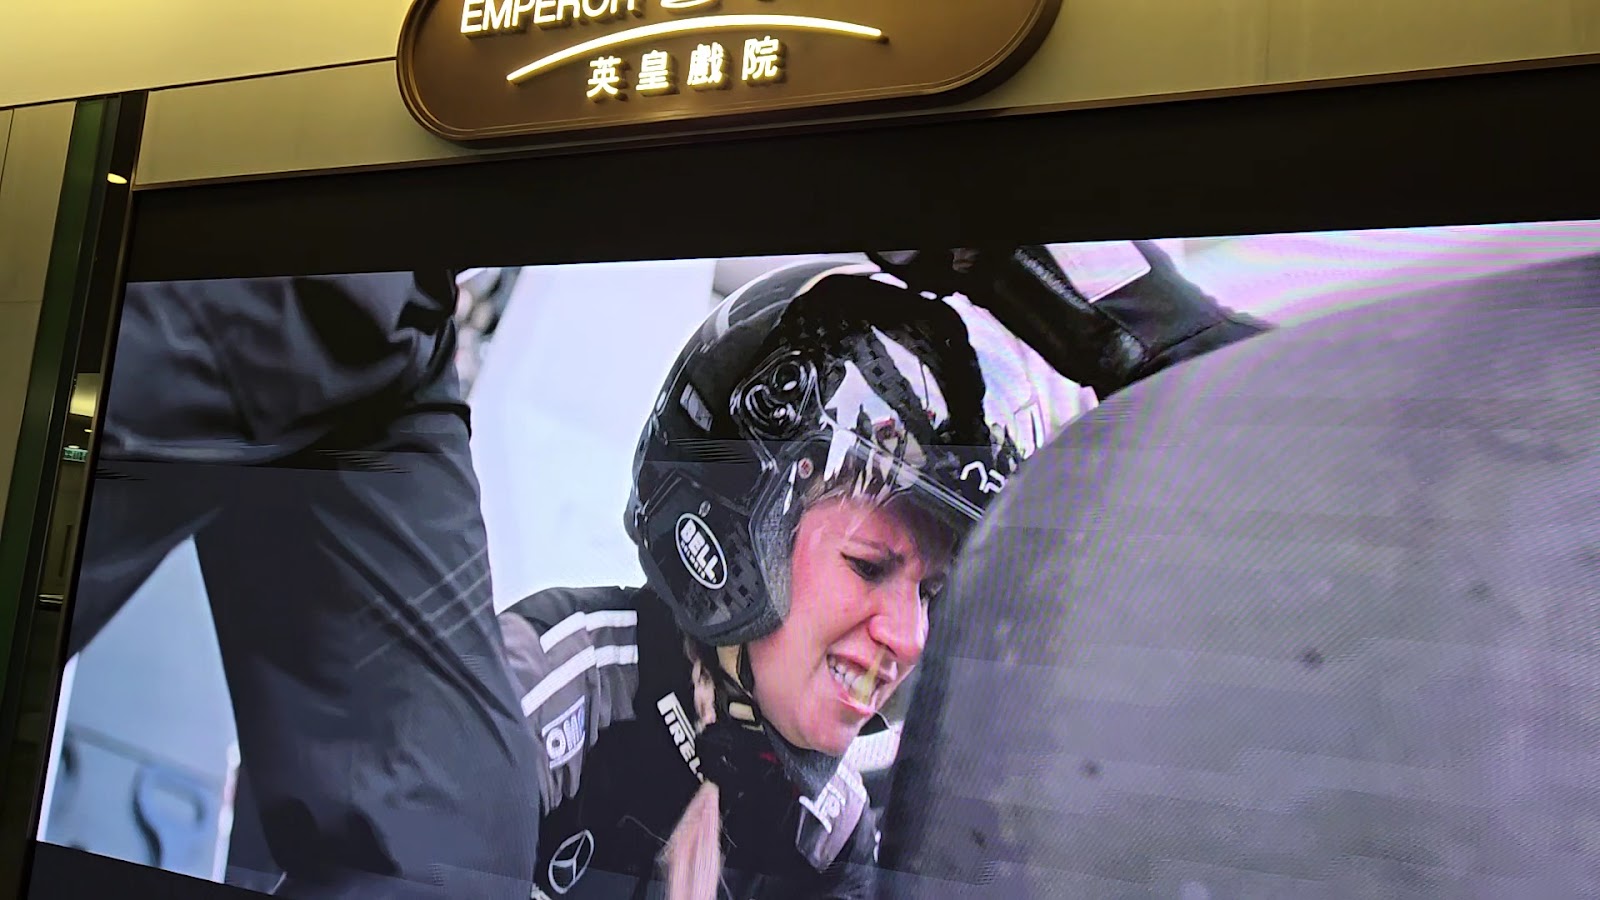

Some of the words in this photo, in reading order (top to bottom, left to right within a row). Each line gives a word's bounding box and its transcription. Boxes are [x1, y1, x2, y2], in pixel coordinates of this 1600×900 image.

[586, 35, 780, 98] 英皇戲院
[680, 519, 718, 581] BELL
